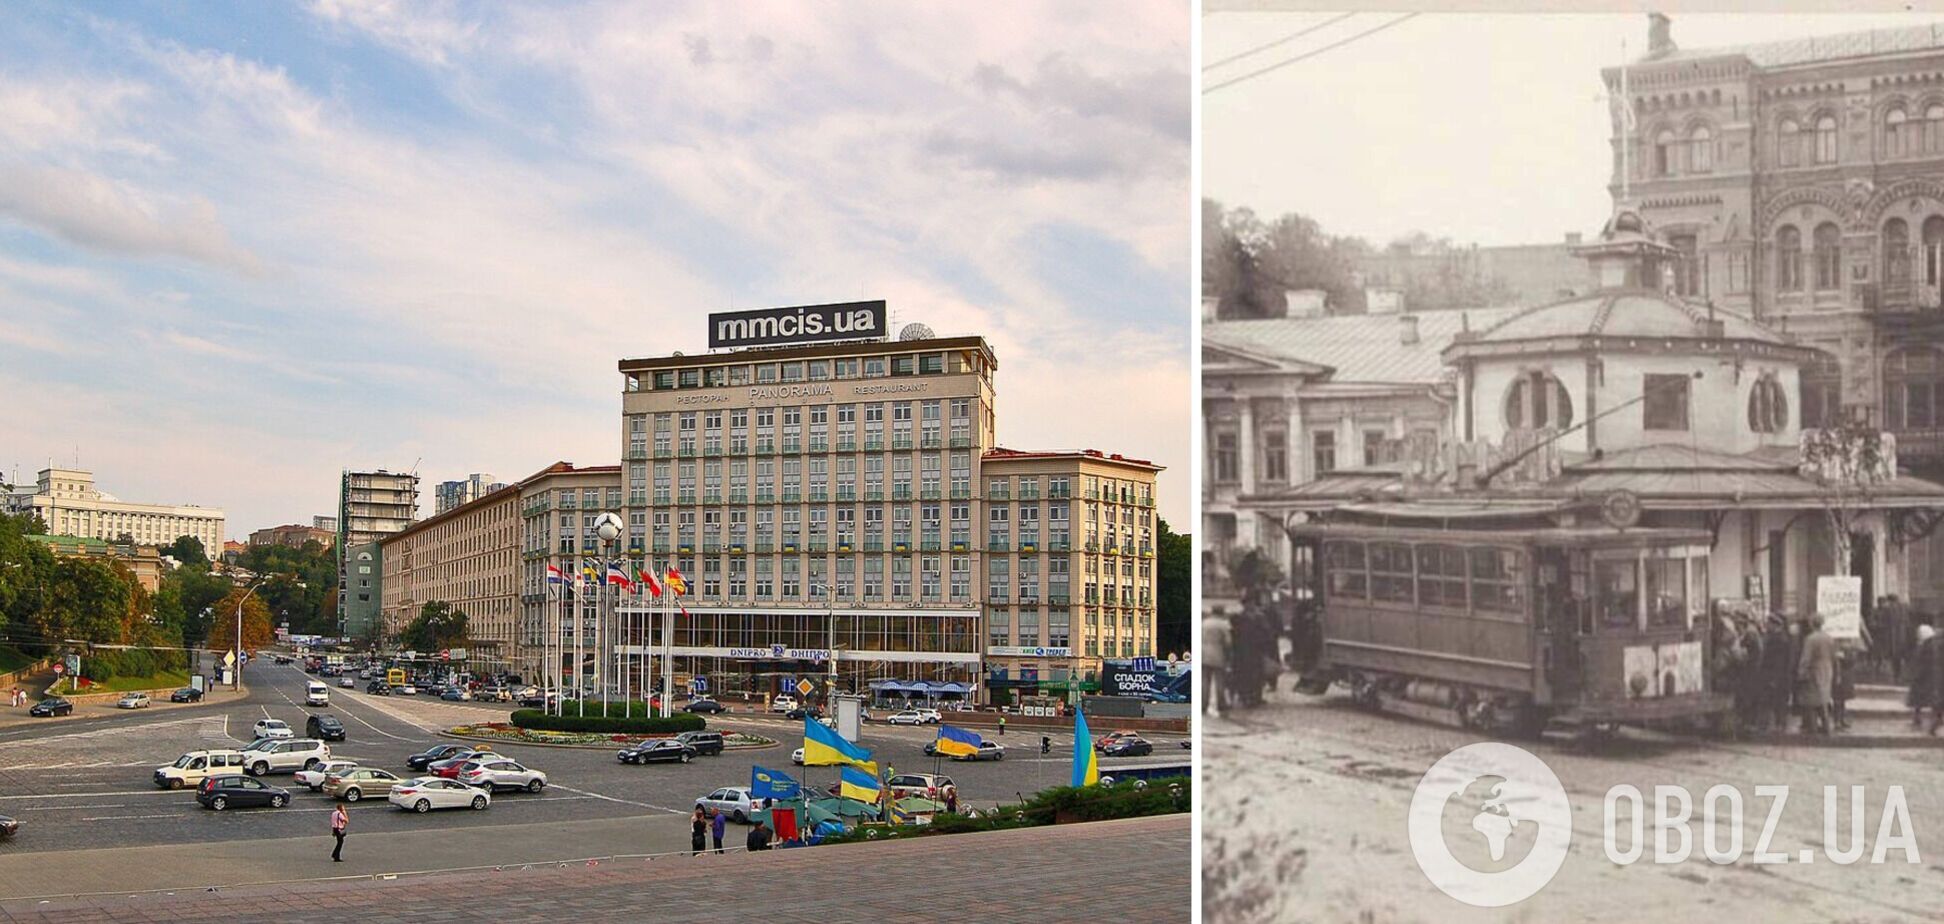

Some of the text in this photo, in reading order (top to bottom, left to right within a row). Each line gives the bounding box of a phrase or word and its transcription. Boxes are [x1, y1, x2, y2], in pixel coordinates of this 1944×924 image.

[718, 308, 875, 341] mmcis.ua
[750, 384, 833, 399] PANORAMA
[854, 382, 928, 395] RESTAURANT
[730, 648, 767, 657] DNIPRO
[1114, 673, 1156, 683] СПАДОК
[1119, 682, 1151, 691] БОРНА
